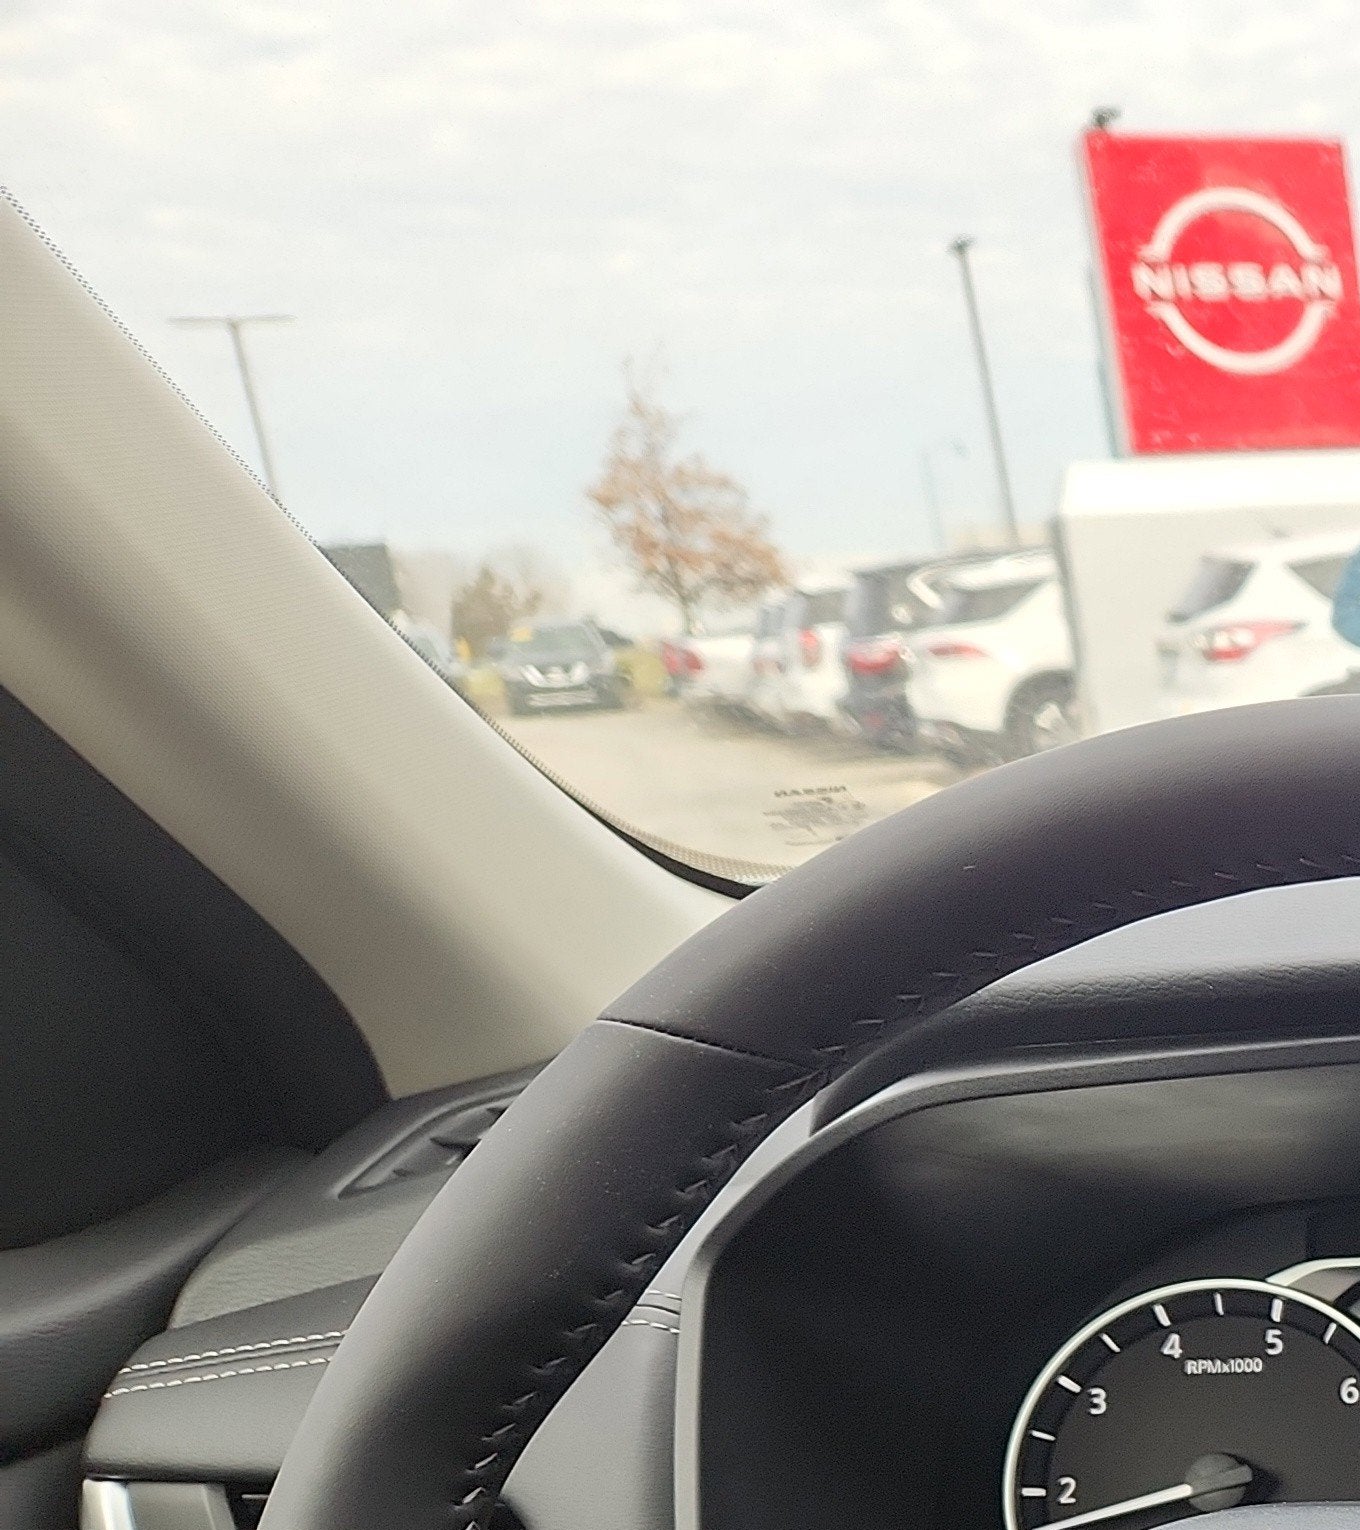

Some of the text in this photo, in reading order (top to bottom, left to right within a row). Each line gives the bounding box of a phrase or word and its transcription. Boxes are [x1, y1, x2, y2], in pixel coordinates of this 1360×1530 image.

[1131, 261, 1343, 302] NISSAN
[1161, 1332, 1183, 1359] 4
[1265, 1329, 1284, 1356] 5
[1183, 1357, 1263, 1375] RPMx1000
[1088, 1387, 1107, 1416] 3
[1339, 1376, 1360, 1405] 6
[1057, 1476, 1078, 1505] 2
